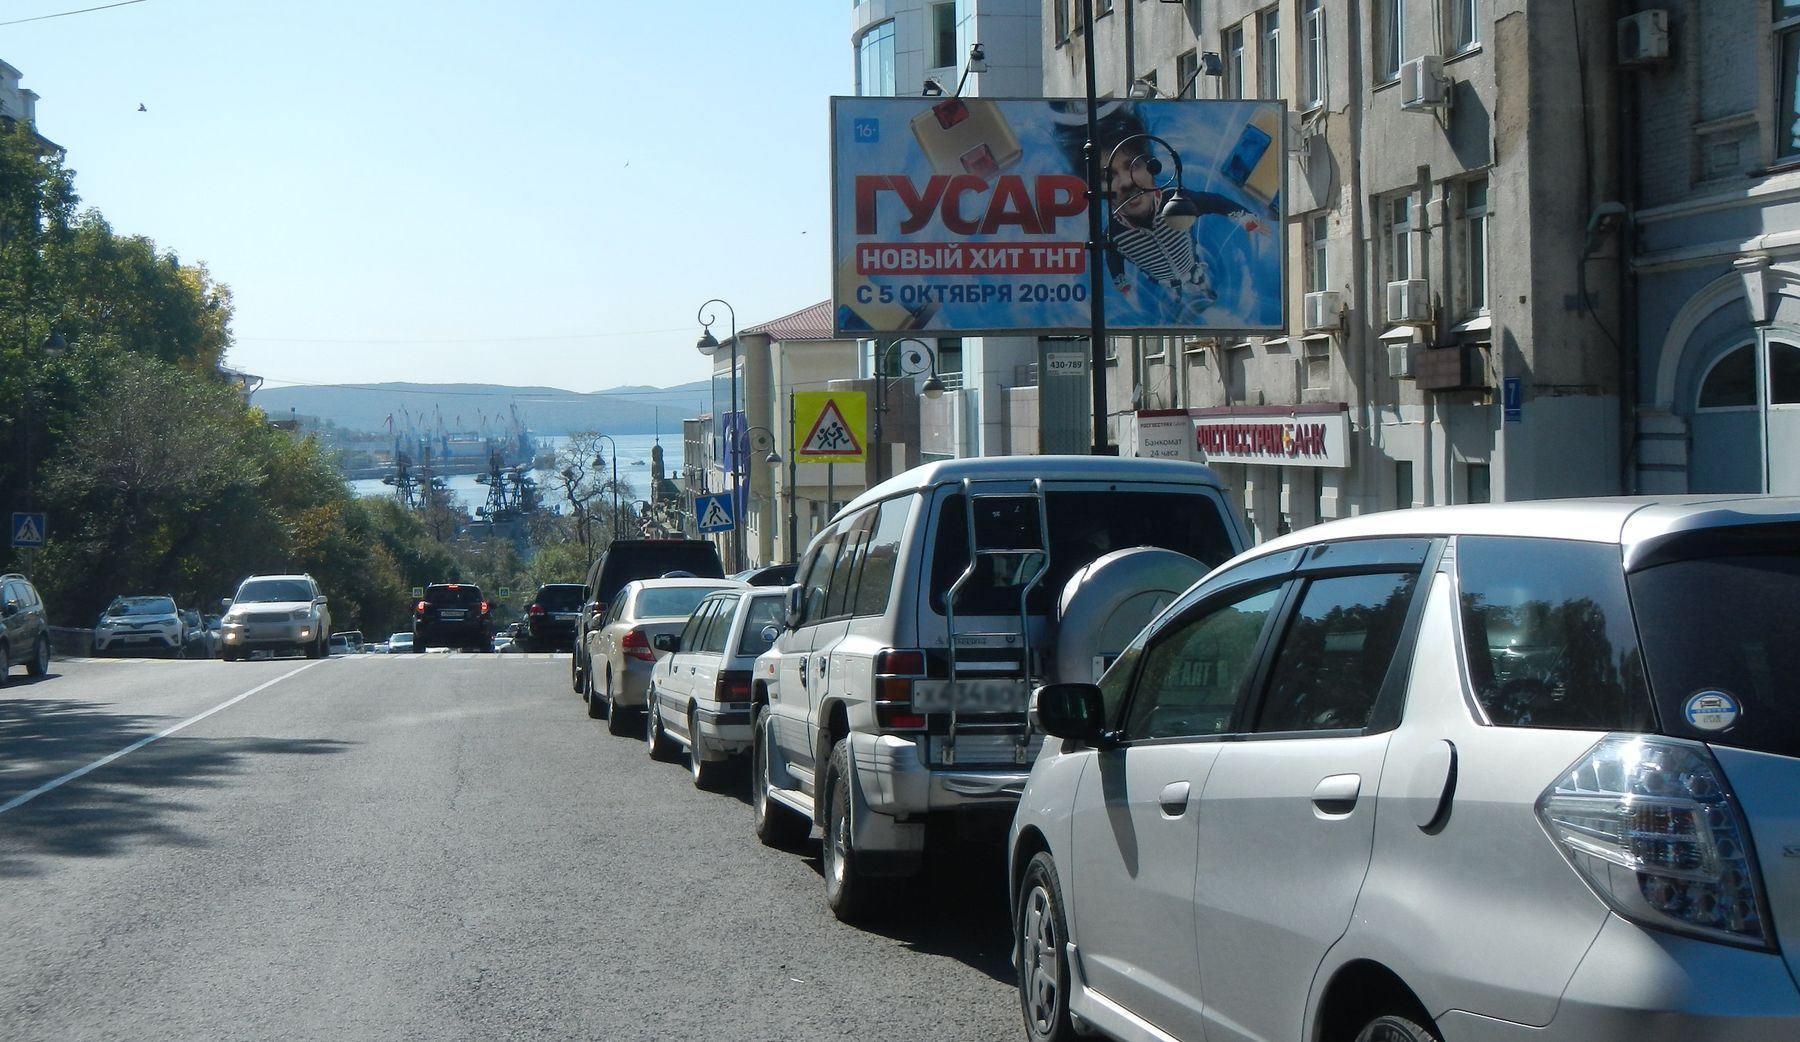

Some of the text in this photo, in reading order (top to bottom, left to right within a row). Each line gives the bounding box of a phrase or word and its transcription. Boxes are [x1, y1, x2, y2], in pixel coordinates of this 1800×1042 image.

[856, 123, 876, 137] 16+
[855, 175, 1089, 235] ГУСАР
[862, 244, 1081, 269] НОВЫЙ ХИТ ТНТ
[856, 284, 1087, 304] С 5 ОКТЯБРЯ 20:00
[1050, 361, 1082, 369] 430-789
[1144, 438, 1182, 447] Банкомат
[1150, 449, 1159, 458] 24
